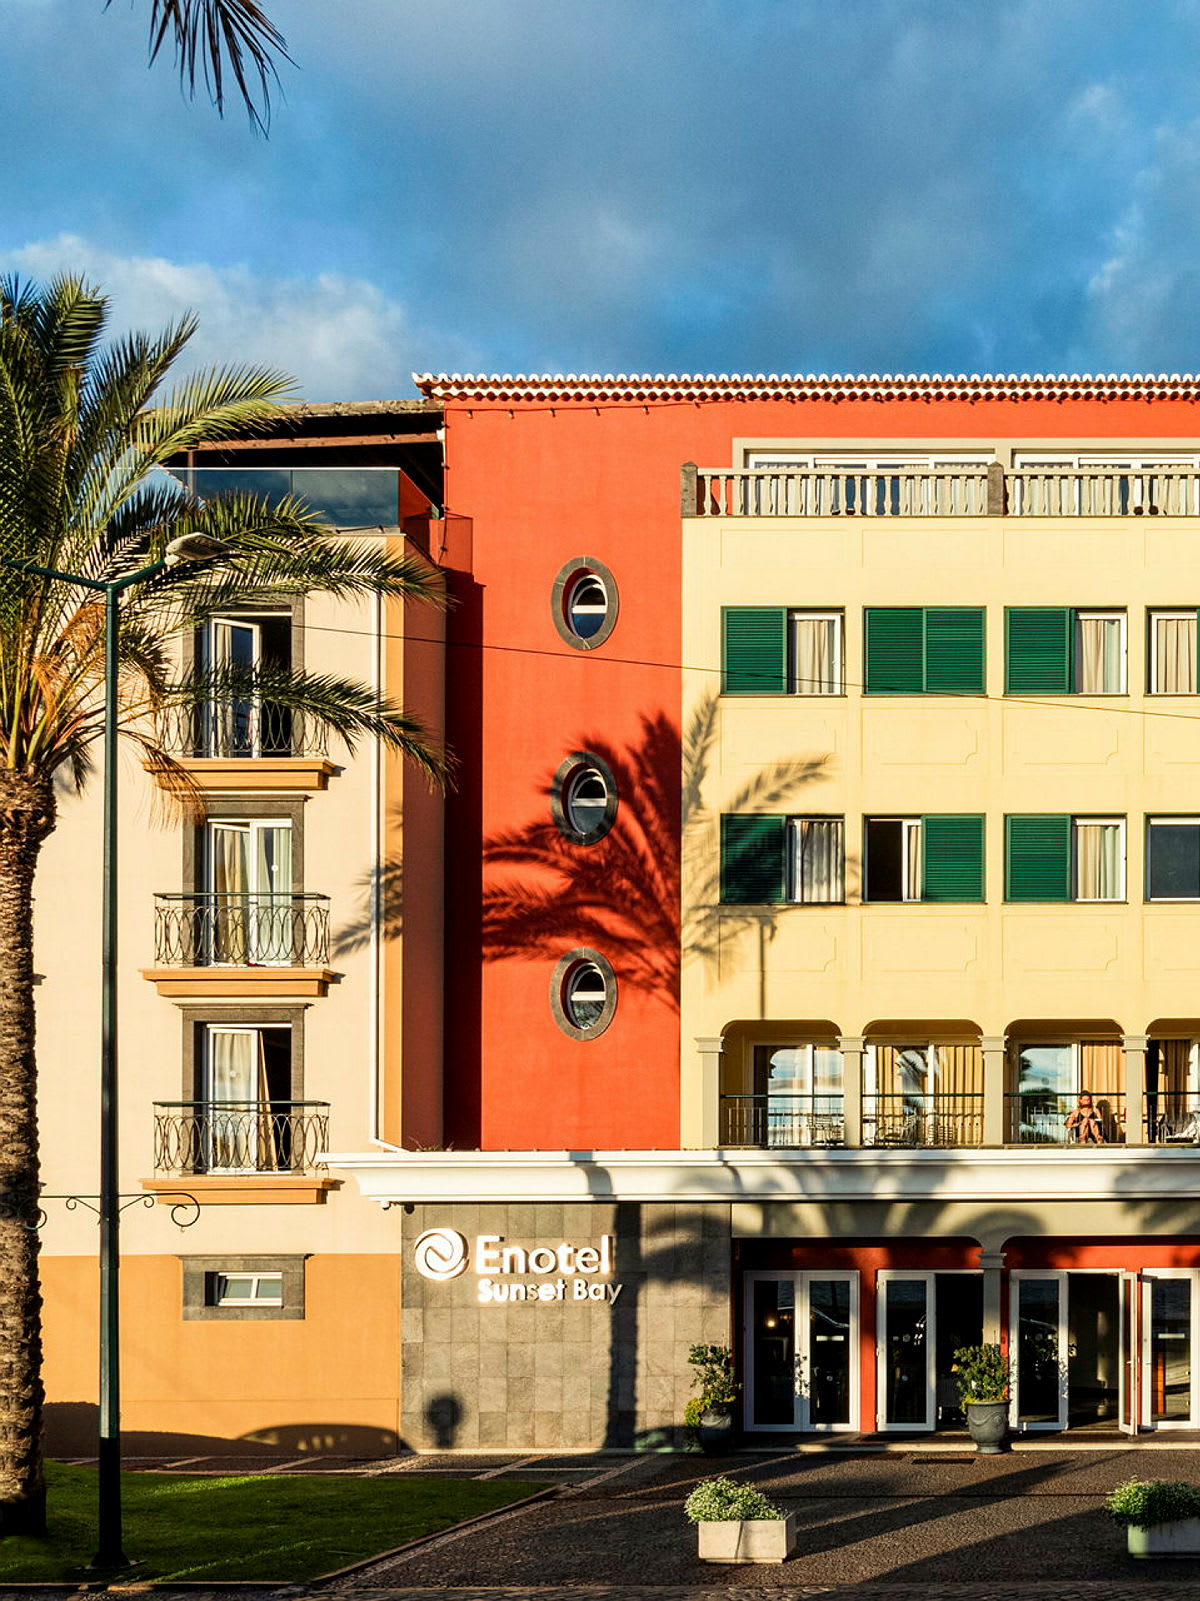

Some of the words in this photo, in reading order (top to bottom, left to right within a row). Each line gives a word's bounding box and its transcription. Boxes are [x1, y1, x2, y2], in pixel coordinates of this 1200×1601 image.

[475, 1235, 614, 1274] Enotel
[477, 1278, 567, 1303] Sunset
[573, 1279, 623, 1304] Bay
